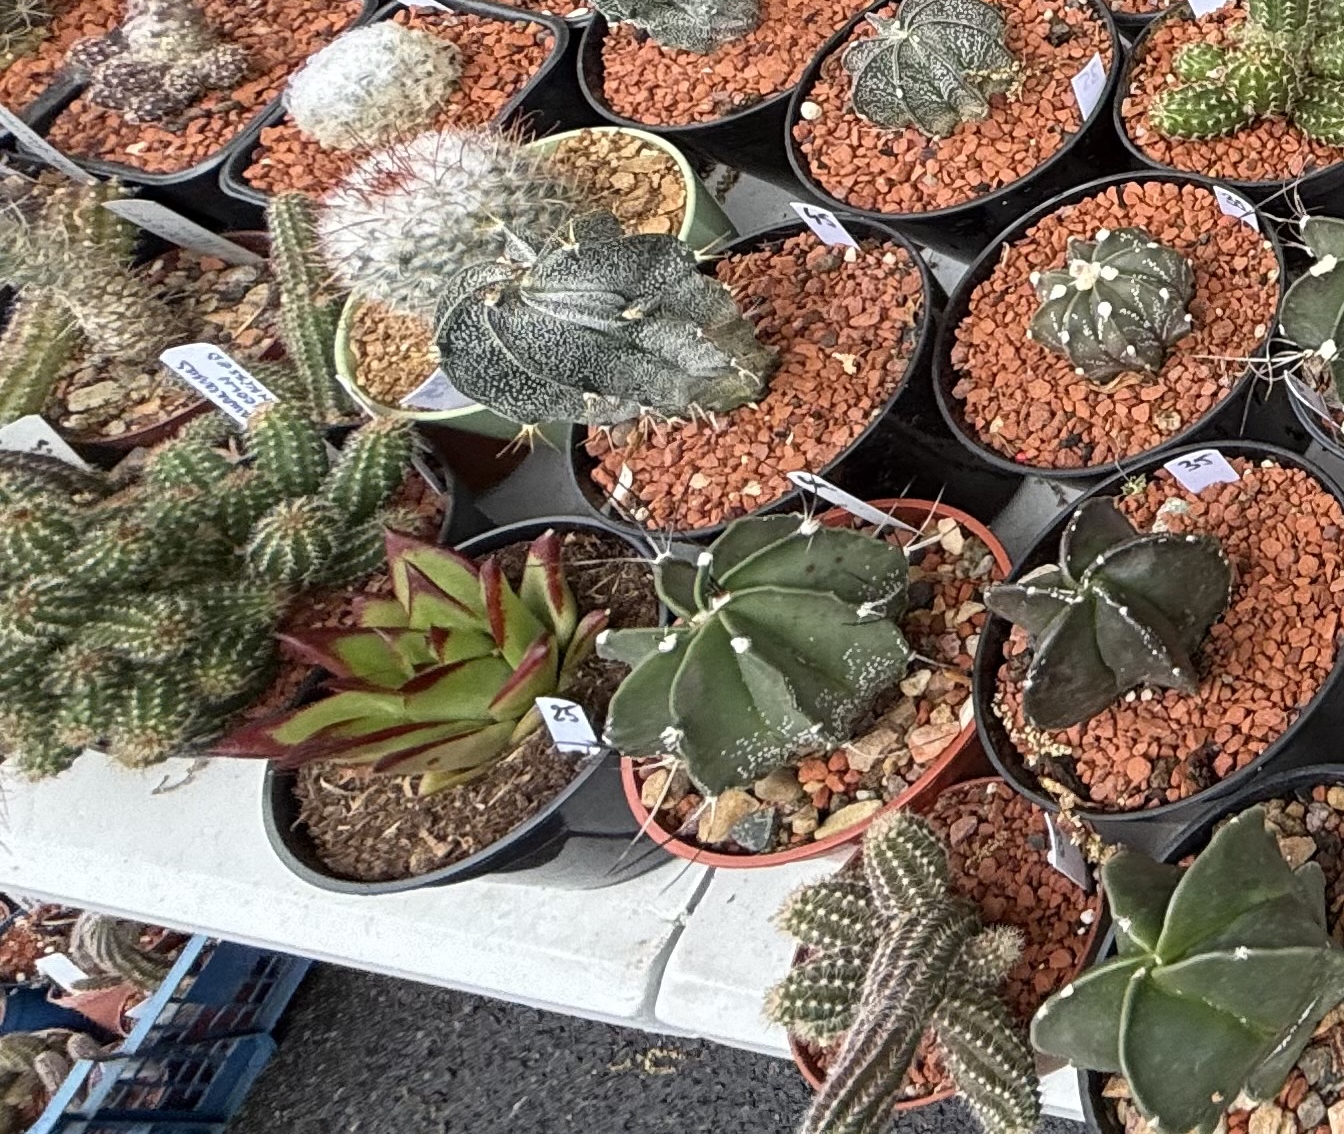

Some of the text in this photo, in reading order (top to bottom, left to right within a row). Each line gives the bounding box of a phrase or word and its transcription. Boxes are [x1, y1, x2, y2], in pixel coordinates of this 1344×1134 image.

[803, 207, 836, 229] 45
[1178, 453, 1214, 471] 35
[550, 704, 580, 722] 25
